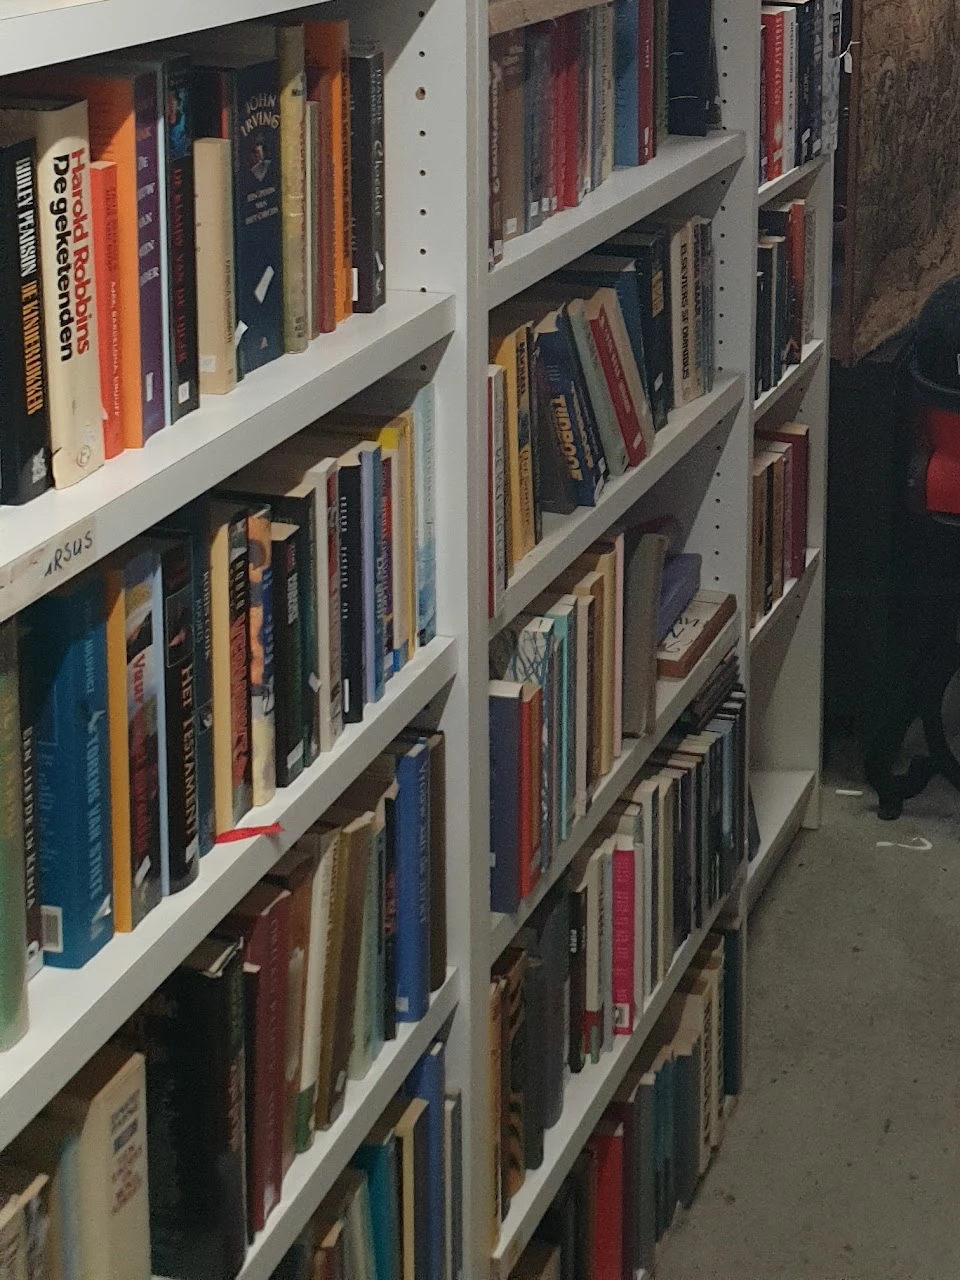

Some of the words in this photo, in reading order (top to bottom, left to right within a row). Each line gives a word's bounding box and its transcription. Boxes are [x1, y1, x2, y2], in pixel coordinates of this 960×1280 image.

[53, 155, 71, 195] De
[71, 148, 90, 244] Harold
[16, 210, 37, 276] PEARSON
[50, 198, 73, 359] geketenden
[74, 245, 93, 356] Robbins
